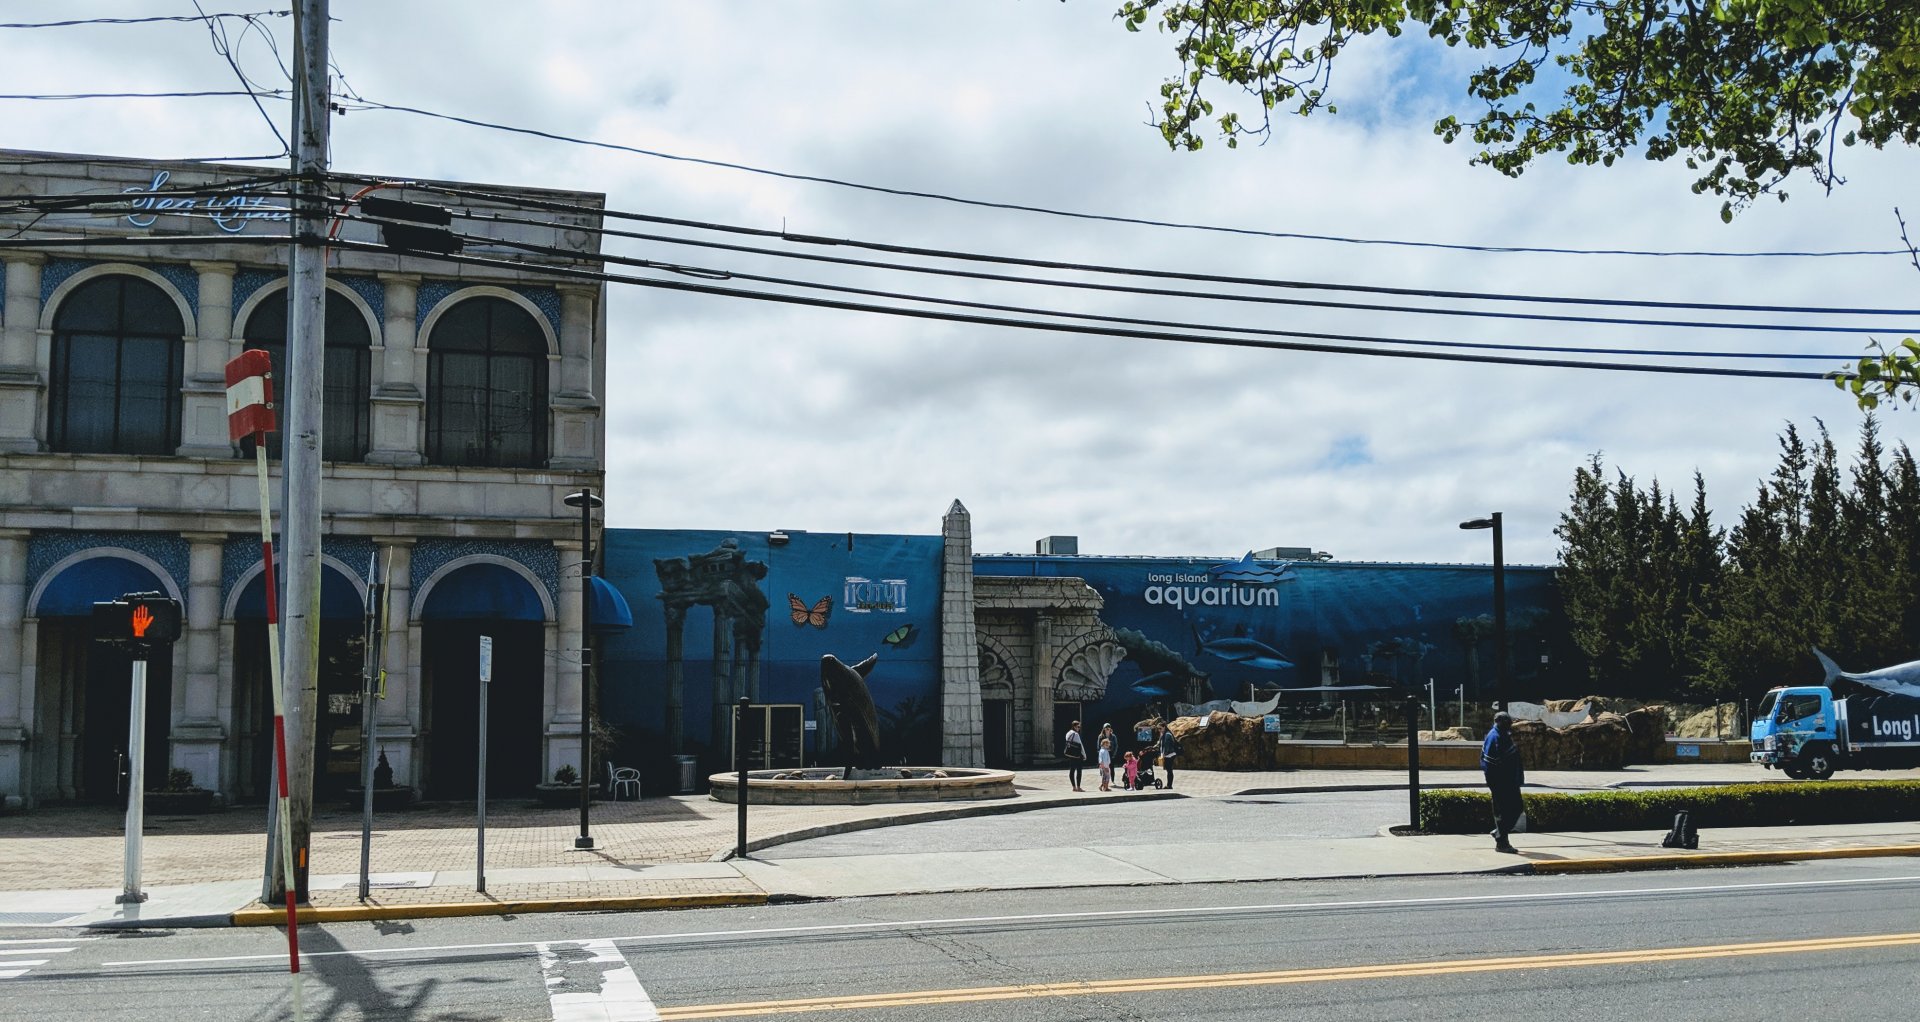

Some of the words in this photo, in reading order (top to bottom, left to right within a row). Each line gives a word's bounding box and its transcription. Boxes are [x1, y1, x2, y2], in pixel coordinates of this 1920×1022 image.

[1148, 572, 1173, 584] long
[1144, 582, 1279, 610] aquarium
[1872, 715, 1912, 741] Long
